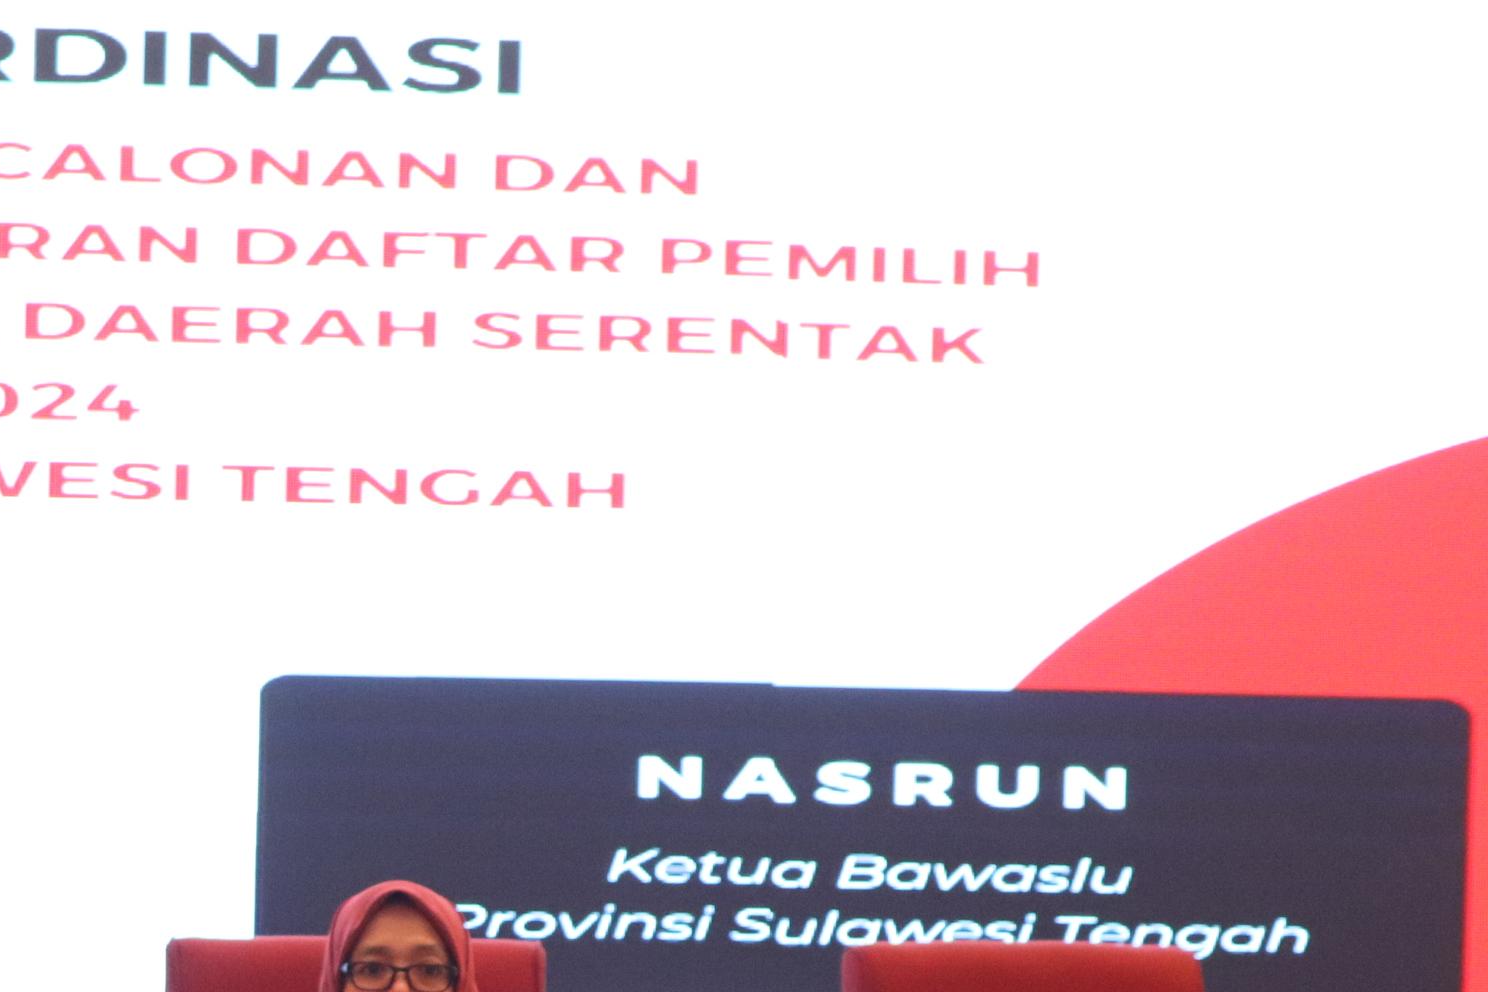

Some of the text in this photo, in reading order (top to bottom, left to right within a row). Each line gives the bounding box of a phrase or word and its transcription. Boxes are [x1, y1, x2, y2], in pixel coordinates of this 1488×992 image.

[495, 154, 699, 195] DAN
[236, 228, 625, 274] DAFTAR
[661, 238, 1040, 287] PEMILIH
[25, 302, 436, 348] DAERAH
[473, 312, 985, 364] SERENTAK
[223, 465, 626, 509] TENGAH
[637, 754, 1129, 811] NASRUN
[607, 847, 1133, 895] Ketua Bawaslu
[729, 907, 1038, 948] Sulawesi
[1054, 915, 1311, 961] Tengah
